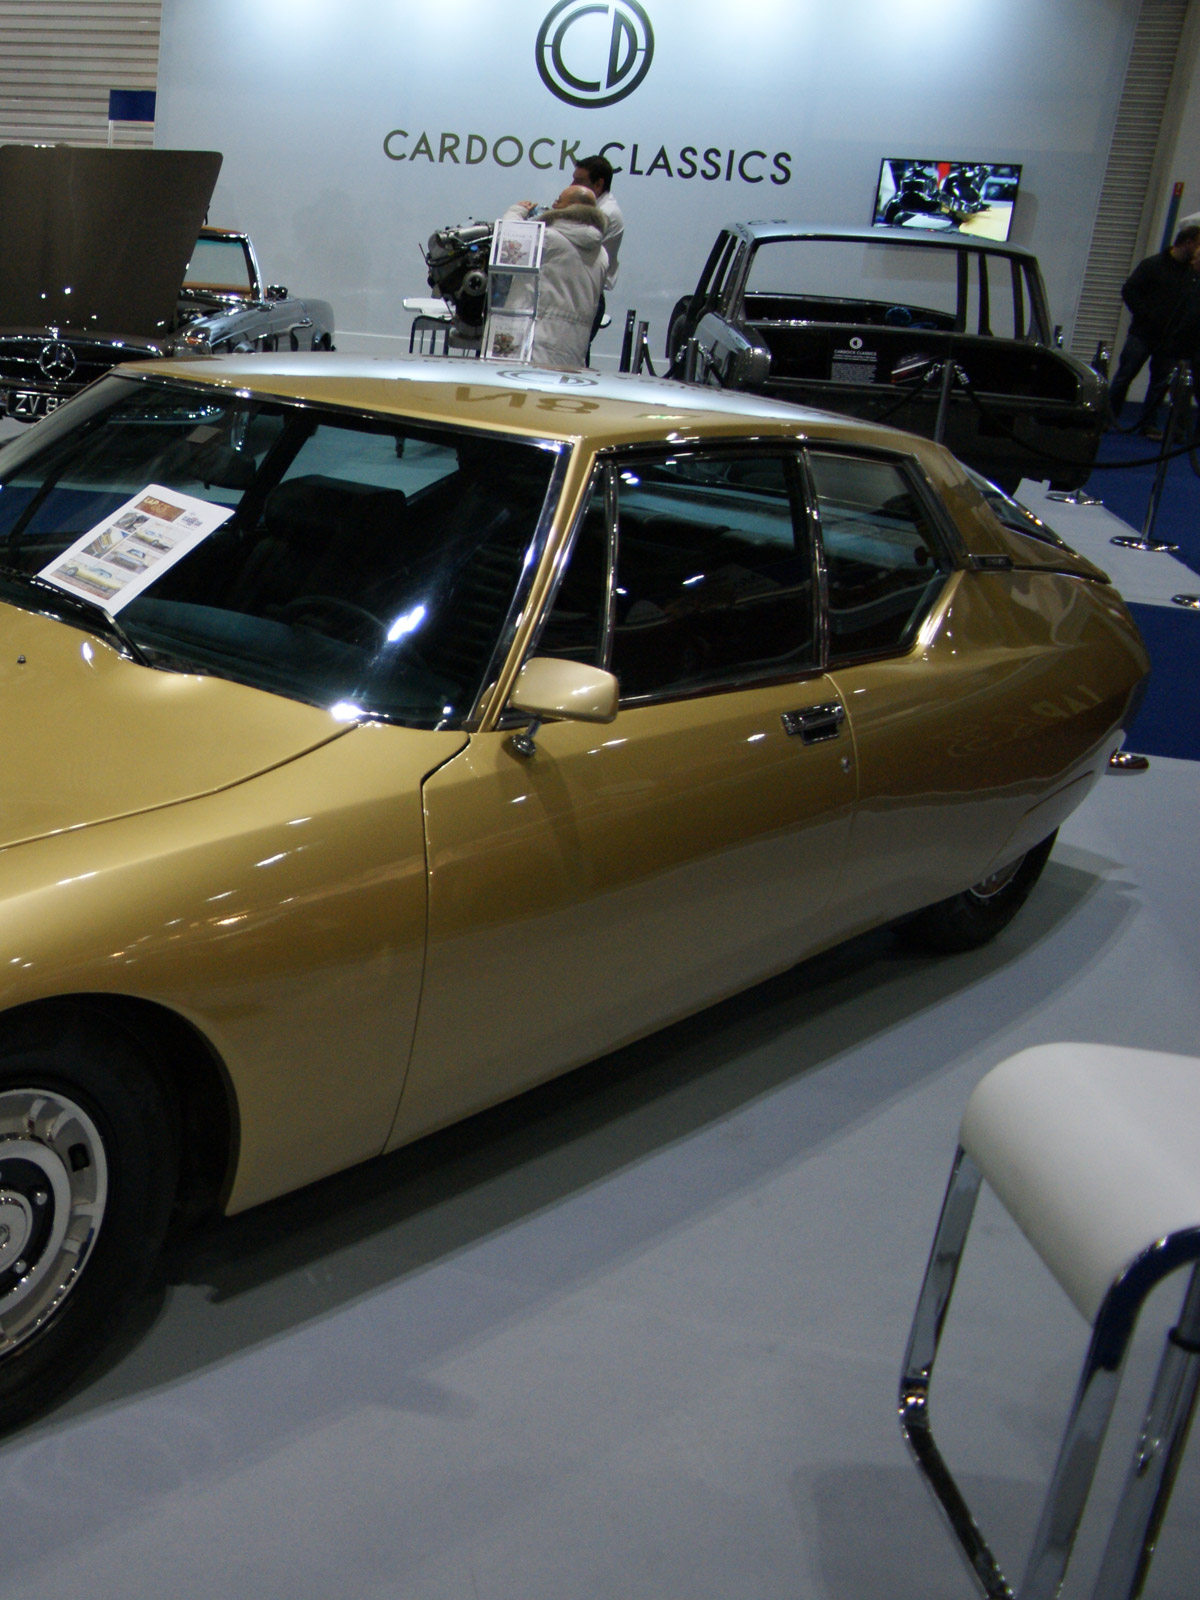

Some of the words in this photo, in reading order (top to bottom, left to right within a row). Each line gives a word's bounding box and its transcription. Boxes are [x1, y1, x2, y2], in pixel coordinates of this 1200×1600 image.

[383, 129, 581, 171] CARDOCK
[598, 141, 792, 185] CLASSICS
[14, 393, 41, 415] ZV
[45, 396, 70, 414] 8
